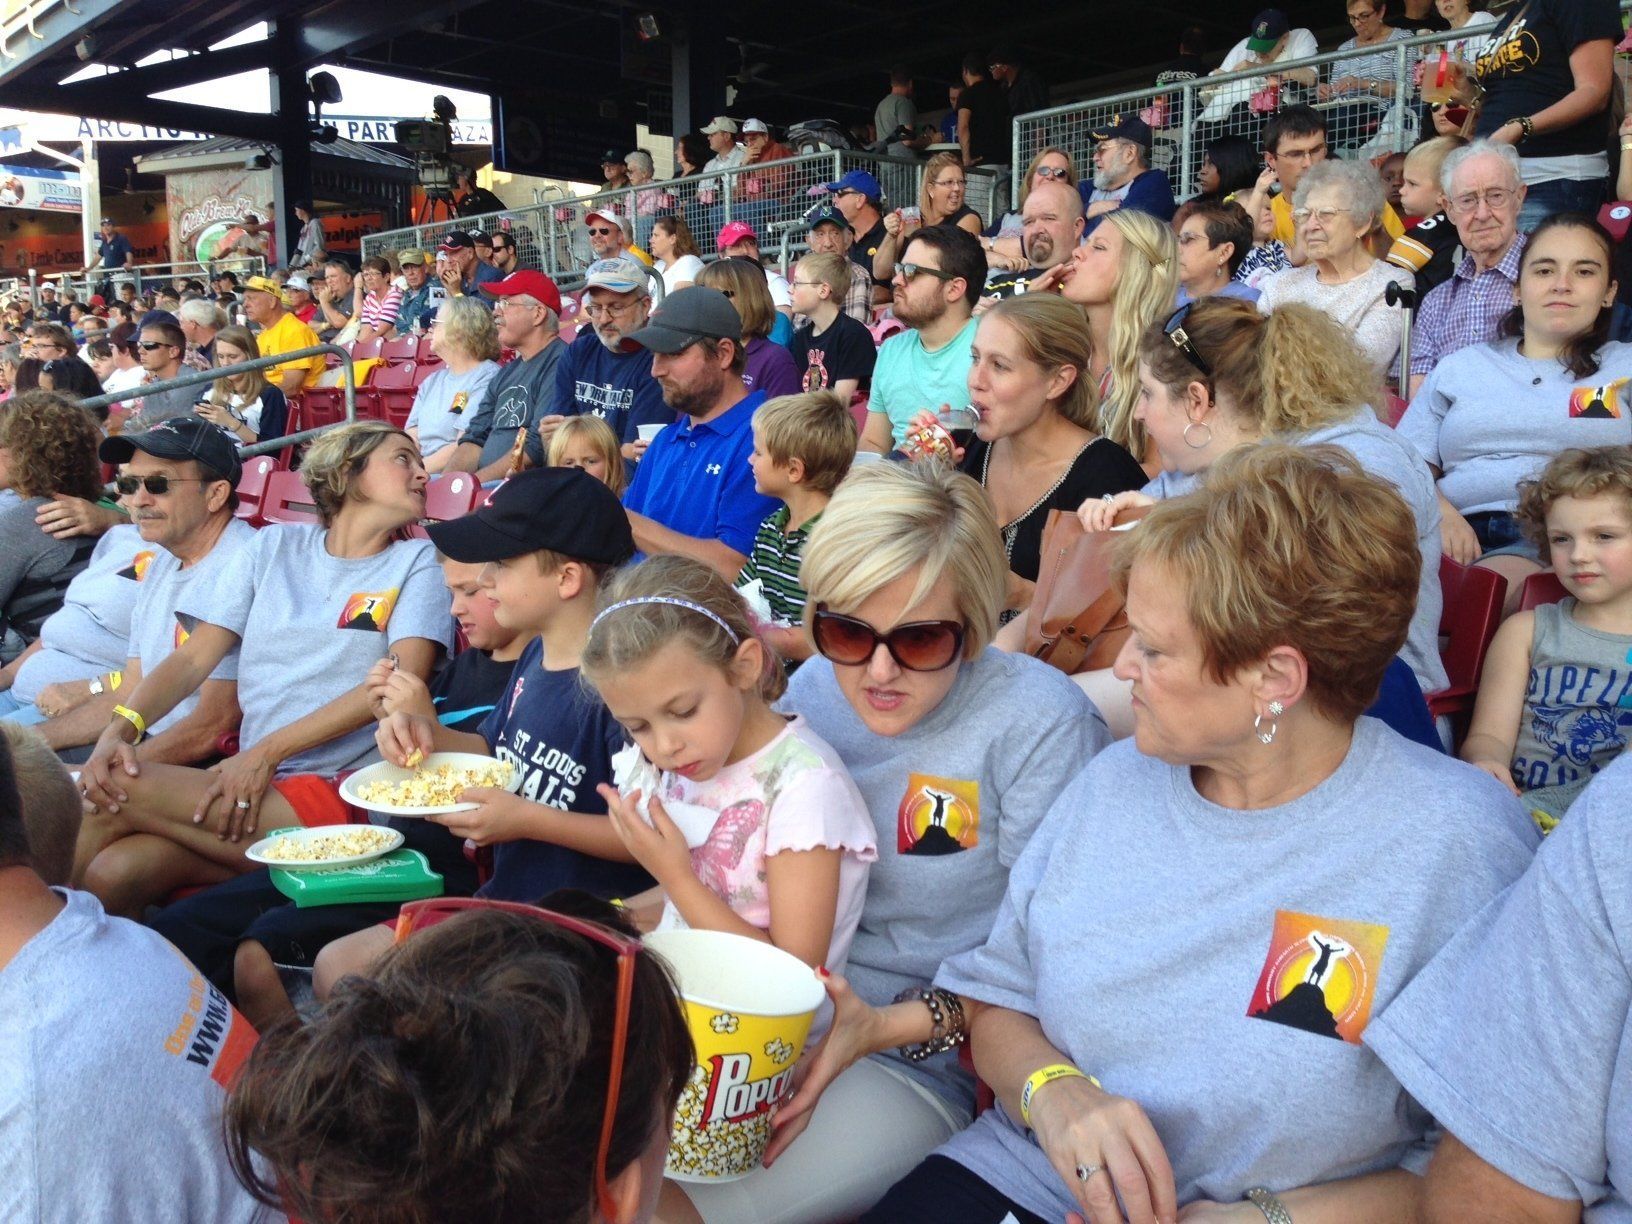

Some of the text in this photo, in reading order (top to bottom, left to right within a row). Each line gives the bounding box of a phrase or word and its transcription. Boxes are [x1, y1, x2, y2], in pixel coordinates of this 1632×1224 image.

[348, 121, 399, 142] PART
[450, 124, 489, 143] AZA
[513, 729, 587, 787] ST. LOUIS
[700, 1053, 797, 1127] POPC
